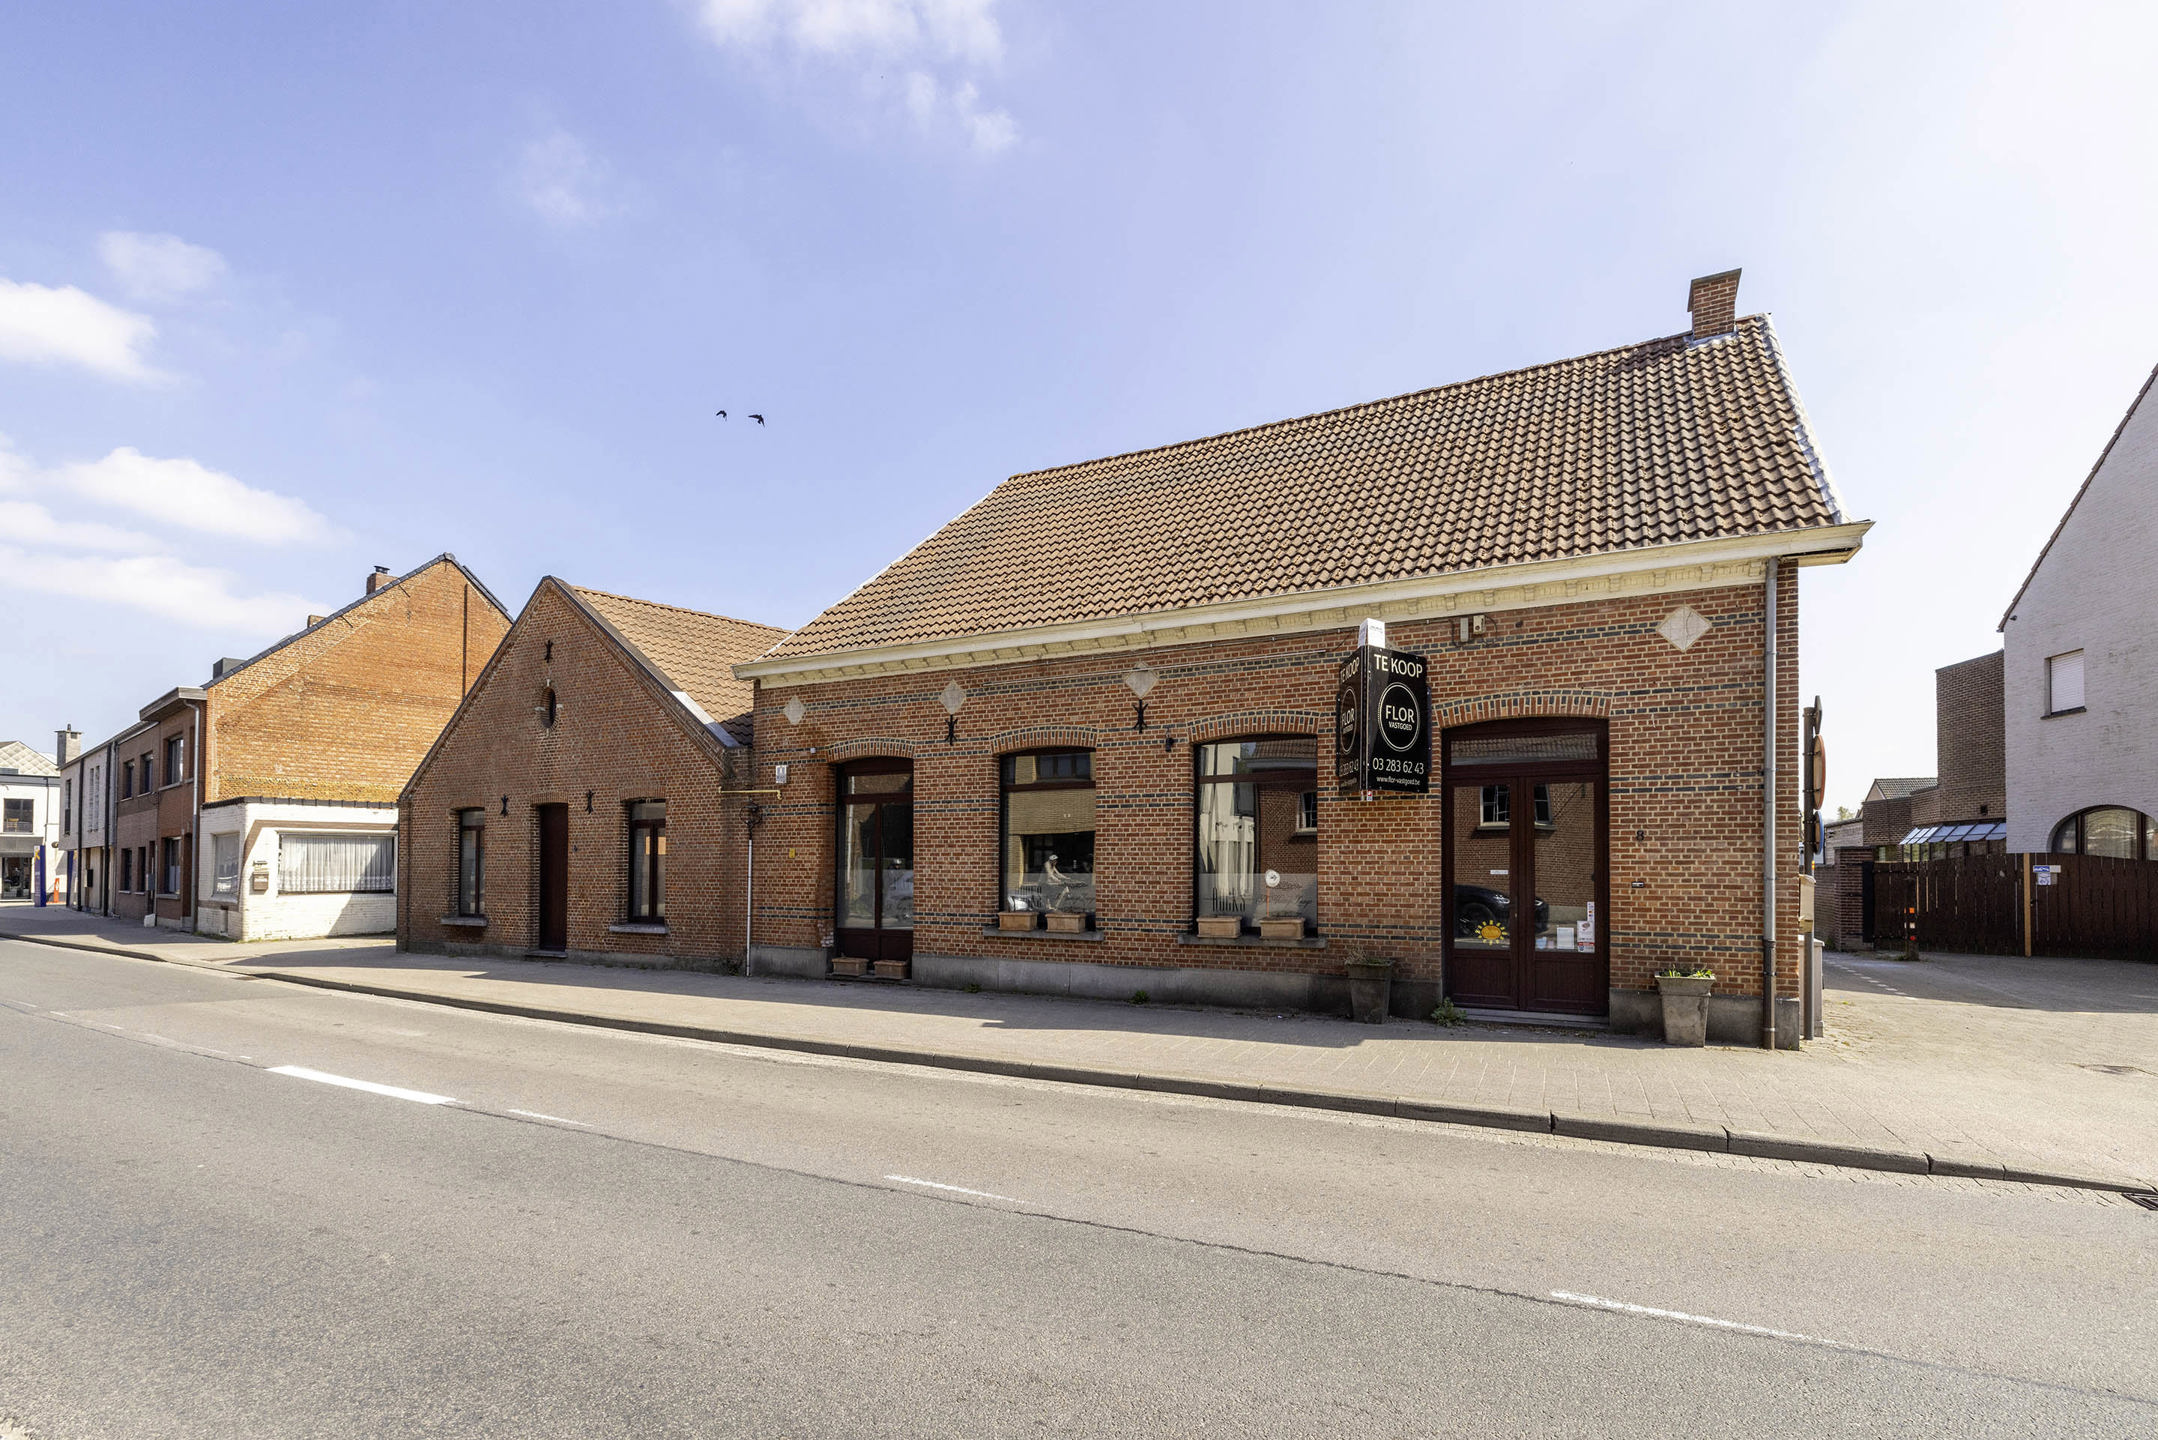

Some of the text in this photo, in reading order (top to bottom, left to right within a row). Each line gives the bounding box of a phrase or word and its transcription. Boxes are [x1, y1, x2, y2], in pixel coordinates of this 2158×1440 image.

[1374, 653, 1423, 678] TE KOOP
[1342, 708, 1354, 725] FLOR
[1385, 705, 1415, 723] FLOR
[1388, 721, 1413, 731] VASTGOED
[1372, 757, 1424, 775] 03 283 62 43
